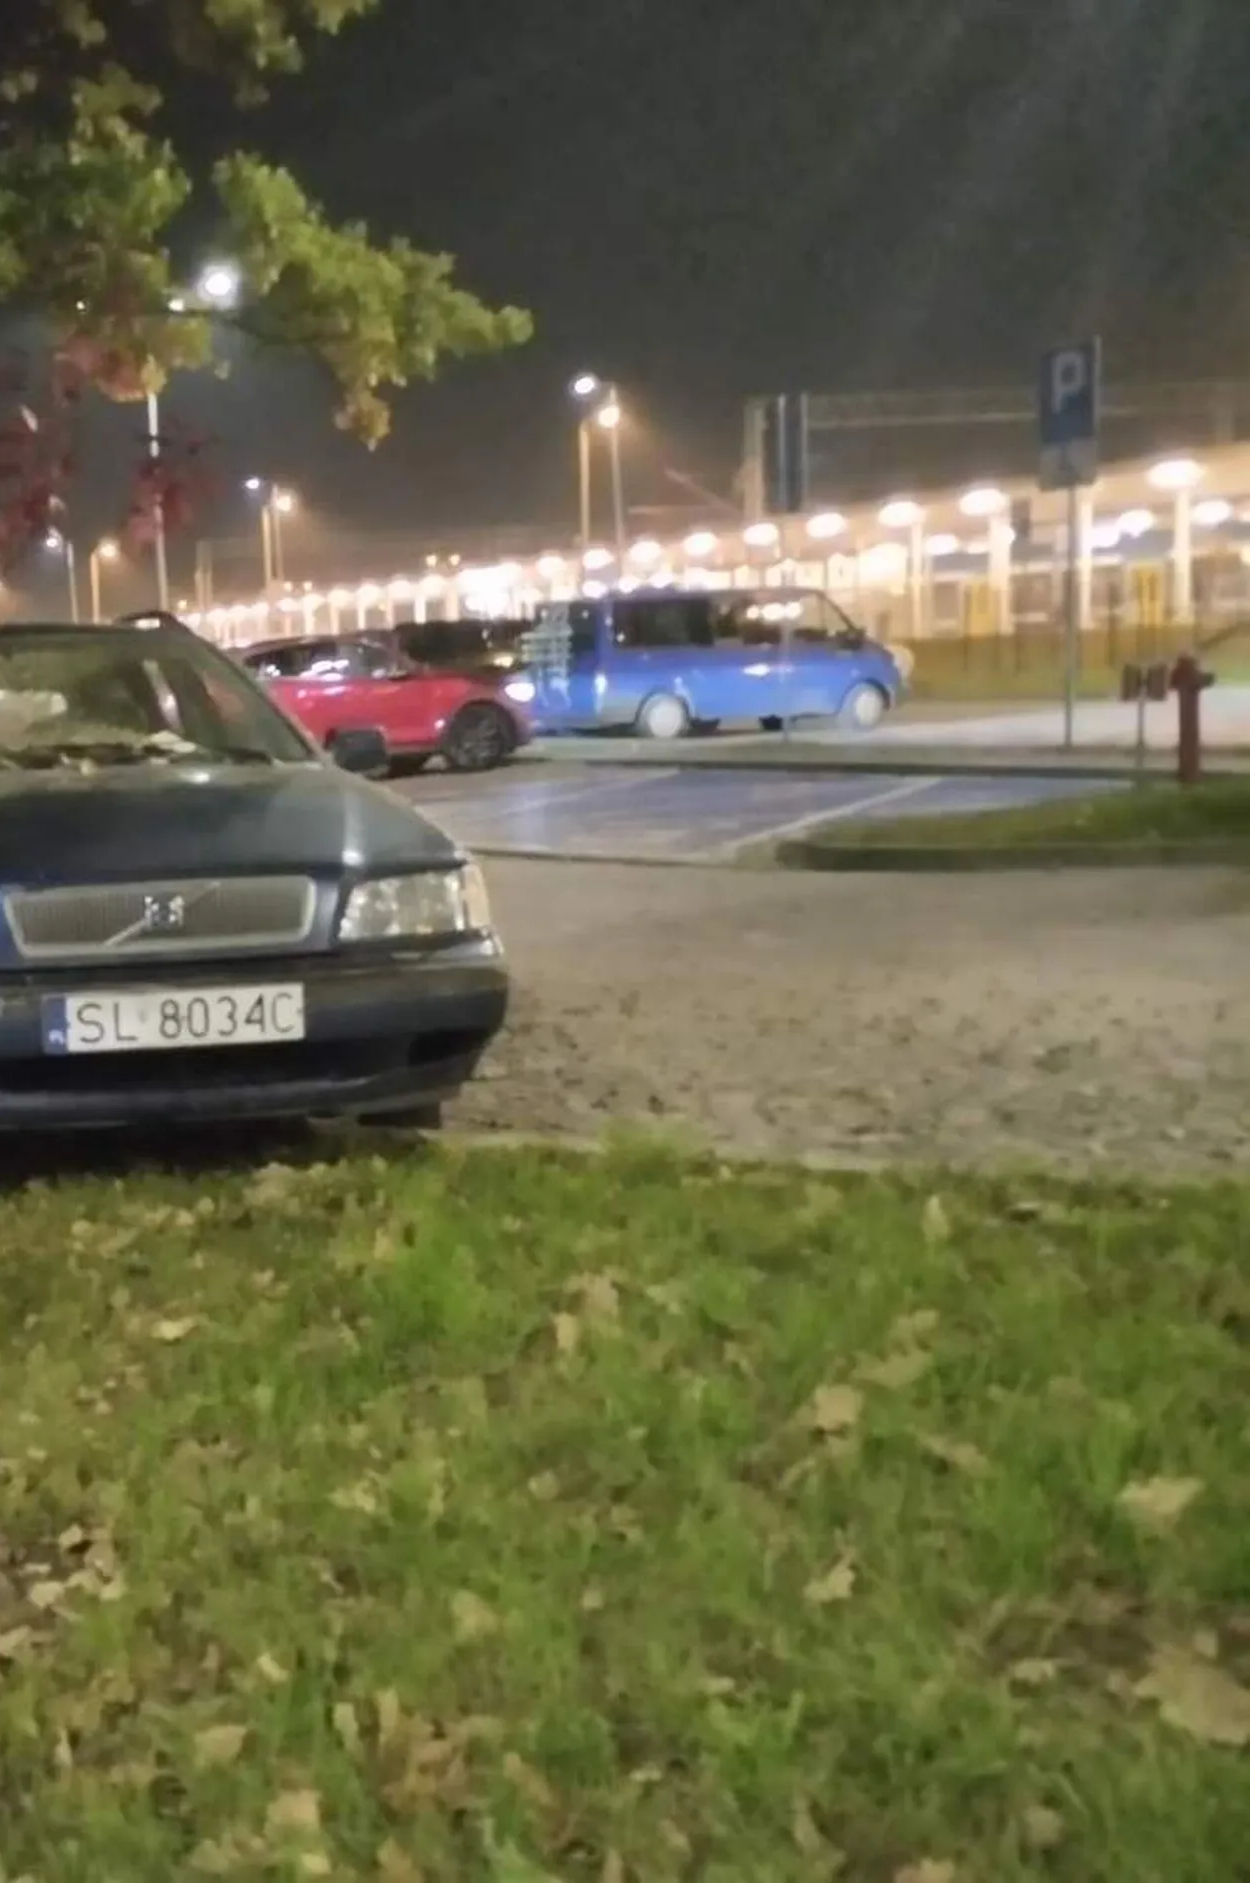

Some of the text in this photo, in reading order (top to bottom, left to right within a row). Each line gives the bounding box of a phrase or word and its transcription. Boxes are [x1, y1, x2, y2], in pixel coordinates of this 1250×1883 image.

[1052, 353, 1085, 414] P
[76, 993, 295, 1043] SL 8034C
